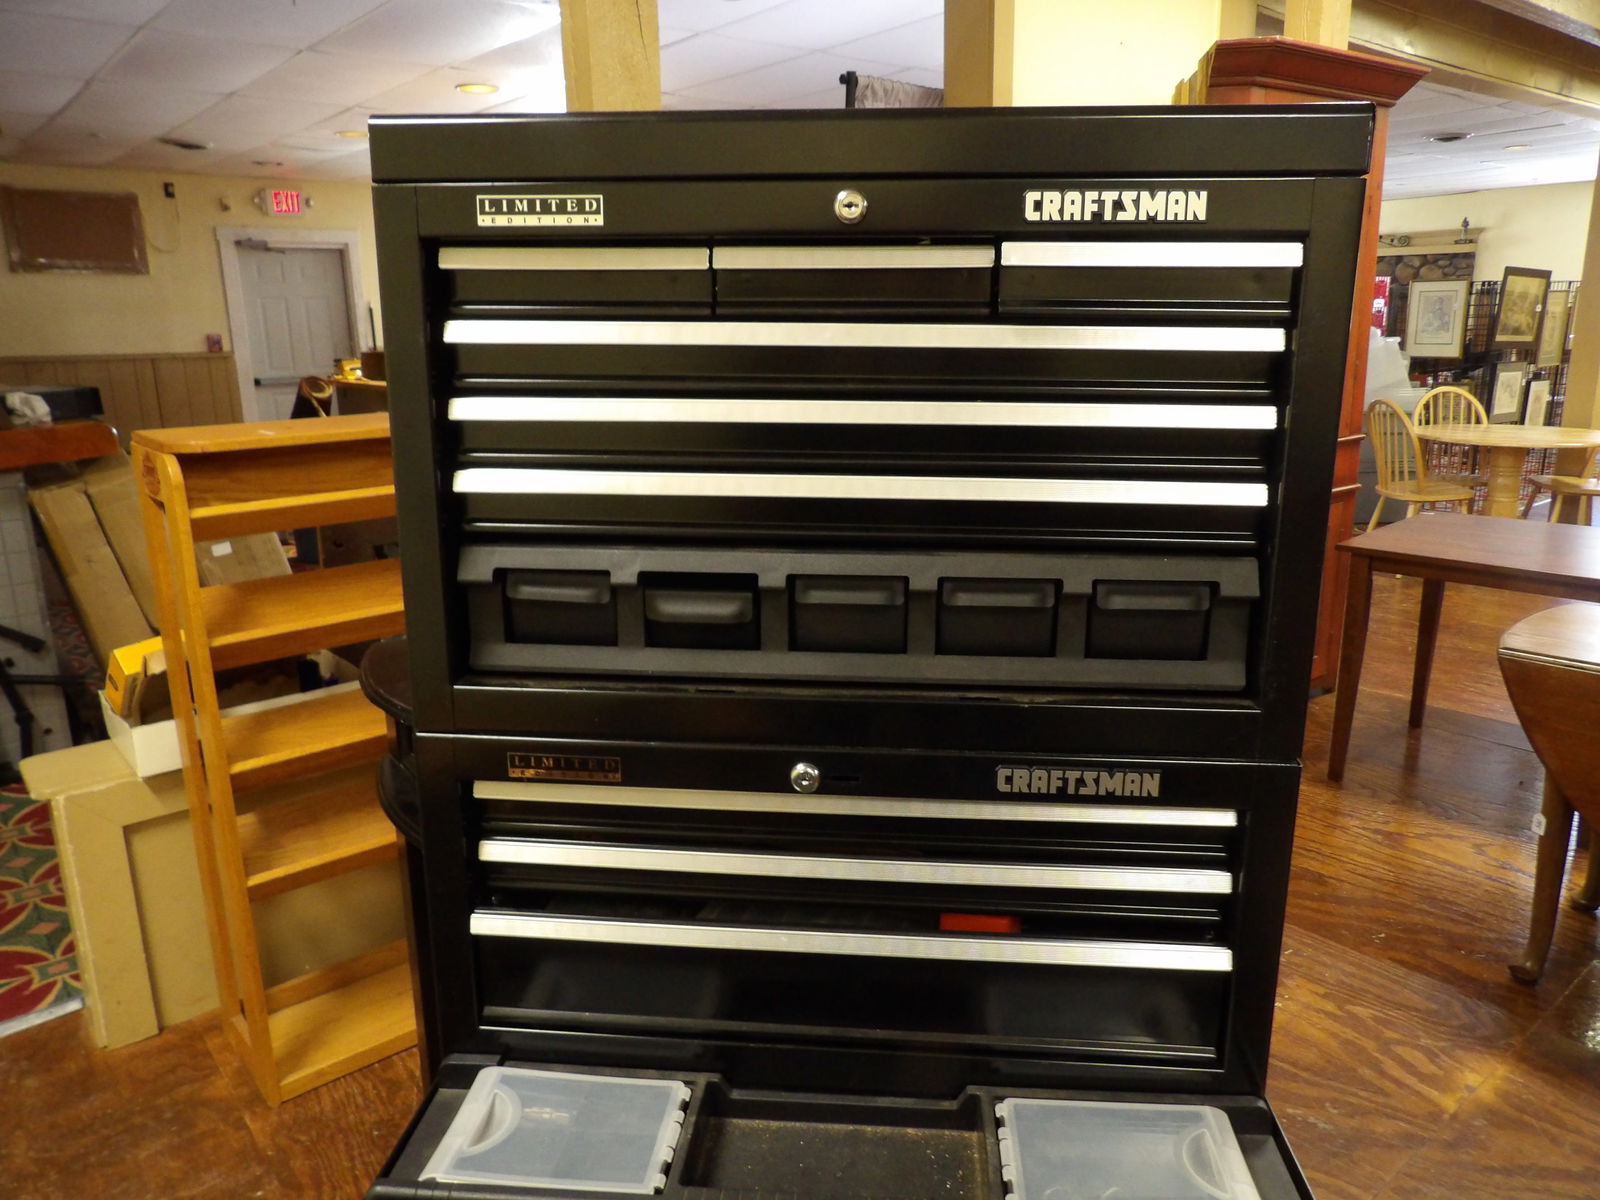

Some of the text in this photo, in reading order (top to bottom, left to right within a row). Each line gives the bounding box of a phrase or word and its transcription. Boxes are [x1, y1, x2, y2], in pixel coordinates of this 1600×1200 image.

[272, 191, 301, 213] EXIT
[484, 198, 598, 213] LIMITED
[1024, 190, 1208, 222] CRAFTSMAN
[491, 216, 591, 225] EDITION
[514, 755, 617, 771] LIMITED
[997, 767, 1162, 798] CRAFTSMAN
